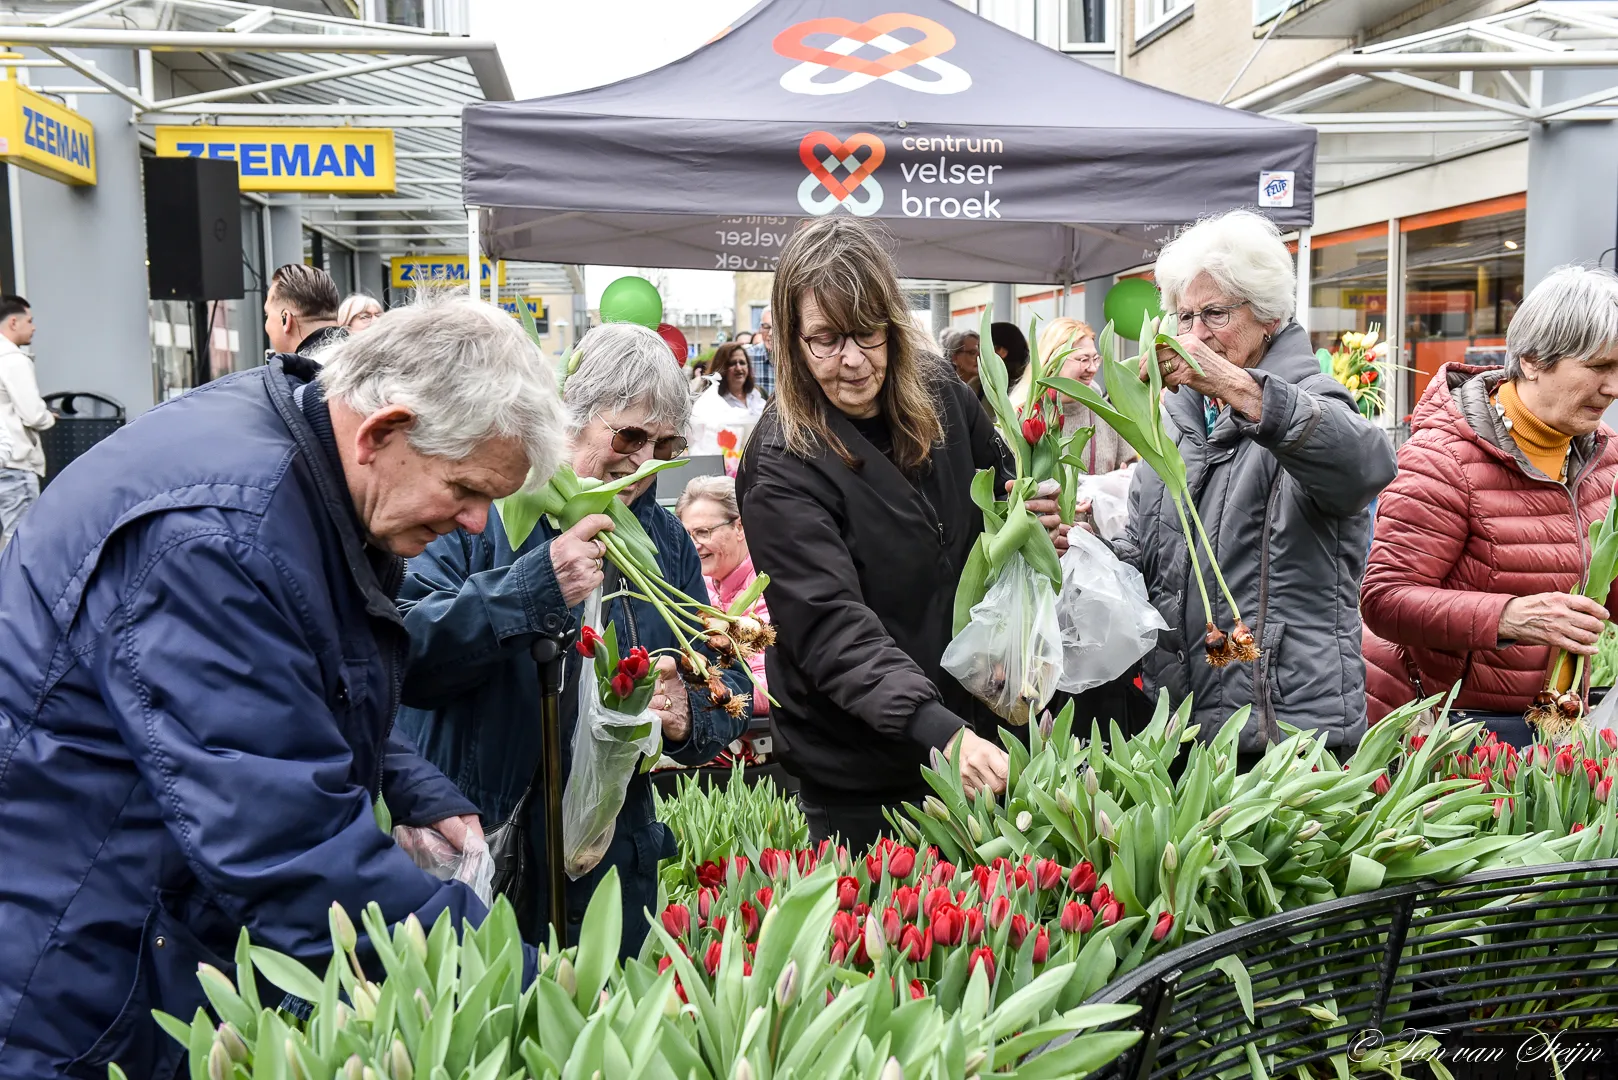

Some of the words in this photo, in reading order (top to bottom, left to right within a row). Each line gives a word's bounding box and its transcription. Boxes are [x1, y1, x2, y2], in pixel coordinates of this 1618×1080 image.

[22, 105, 91, 169] ZEEMAN
[902, 134, 1004, 153] centrum
[900, 156, 1003, 185] velser
[901, 188, 1002, 218] broek
